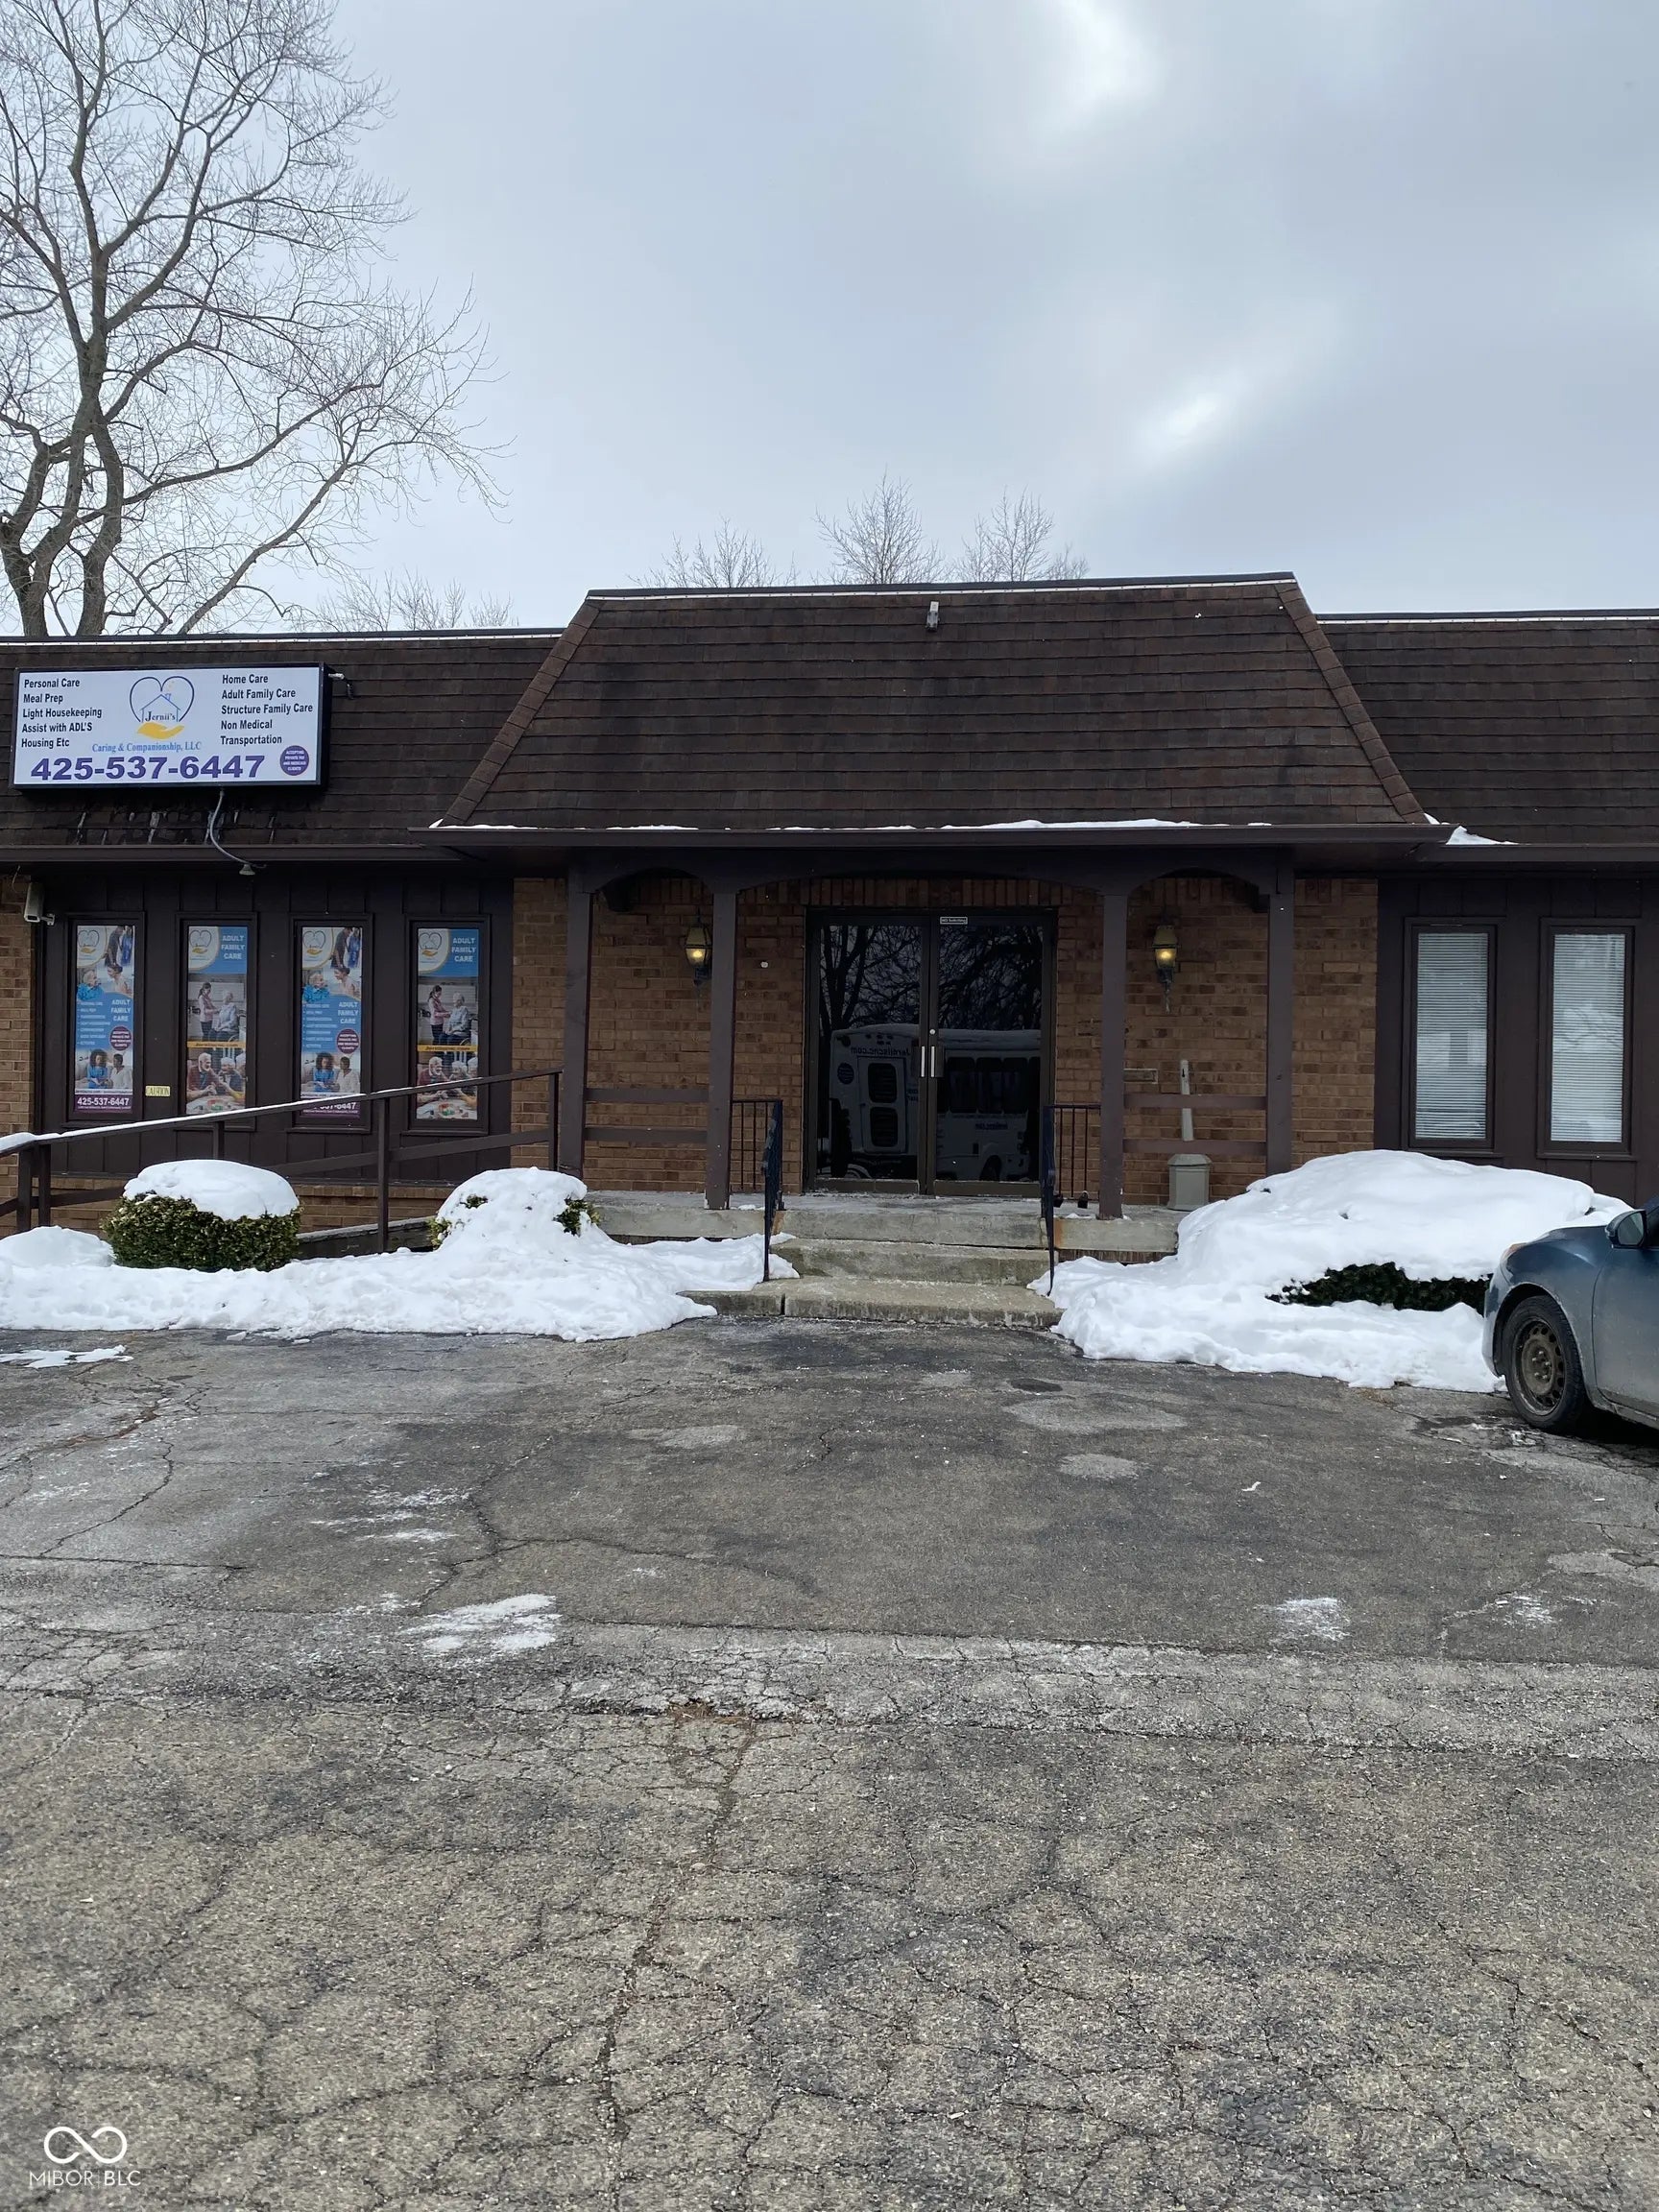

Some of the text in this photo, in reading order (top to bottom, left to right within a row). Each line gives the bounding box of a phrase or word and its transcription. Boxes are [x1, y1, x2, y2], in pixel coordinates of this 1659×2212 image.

[24, 678, 80, 688] Personal Care
[222, 674, 268, 685] Home Care
[23, 693, 63, 705] Meal Prep
[222, 688, 296, 701] Adult Family Care
[23, 707, 102, 720] Light Housekeeping
[222, 704, 313, 715] Structure Family Care
[22, 722, 93, 733] Assist with ADL'S
[221, 719, 273, 730] Non Medical
[21, 738, 70, 750] Housing Etc
[221, 734, 282, 747] Transportation
[92, 741, 202, 753] Caring & Companionship, LLC
[31, 755, 265, 781] 425-537-6447
[77, 1097, 130, 1106] 425-537-6447
